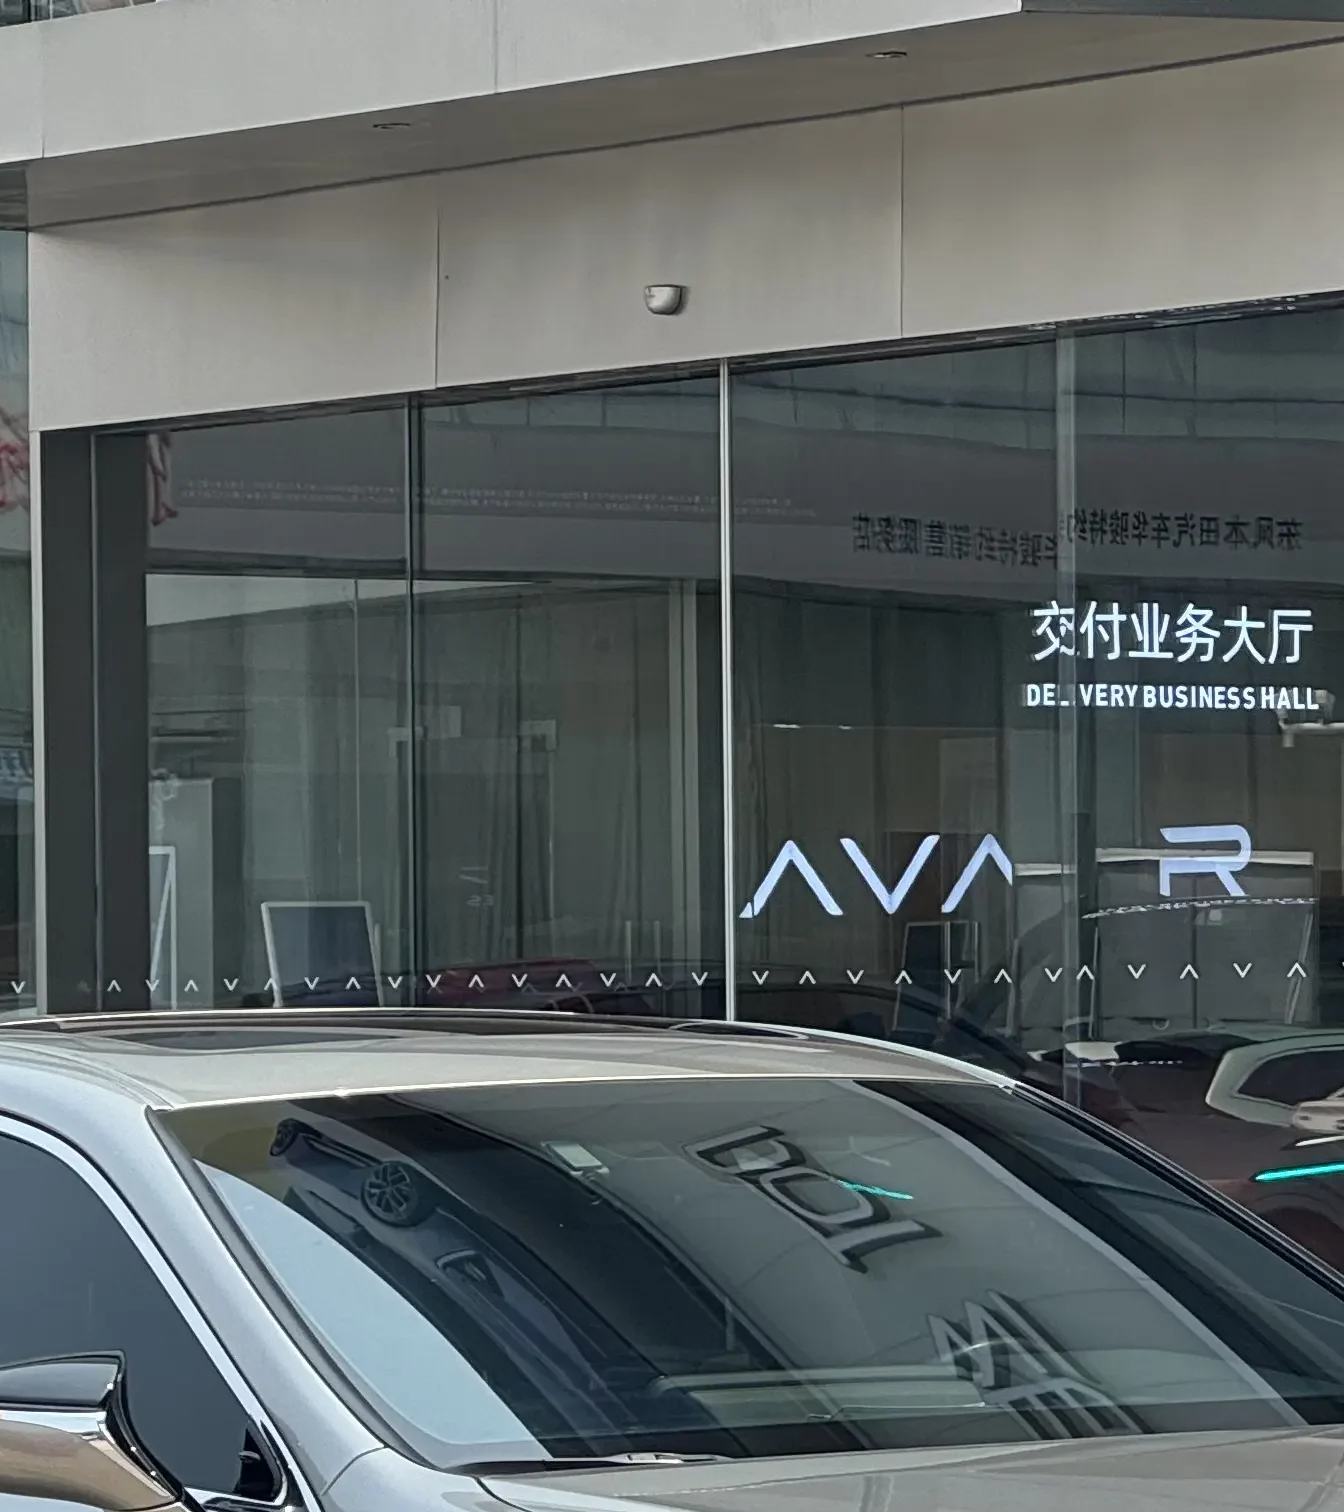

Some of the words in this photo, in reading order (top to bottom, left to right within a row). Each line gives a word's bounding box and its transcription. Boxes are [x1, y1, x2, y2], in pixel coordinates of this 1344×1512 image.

[1033, 601, 1314, 664] 交付业务大厅
[1026, 683, 1139, 708] DEVERY
[1143, 685, 1256, 710] BUSINESS
[1260, 687, 1319, 710] HALL
